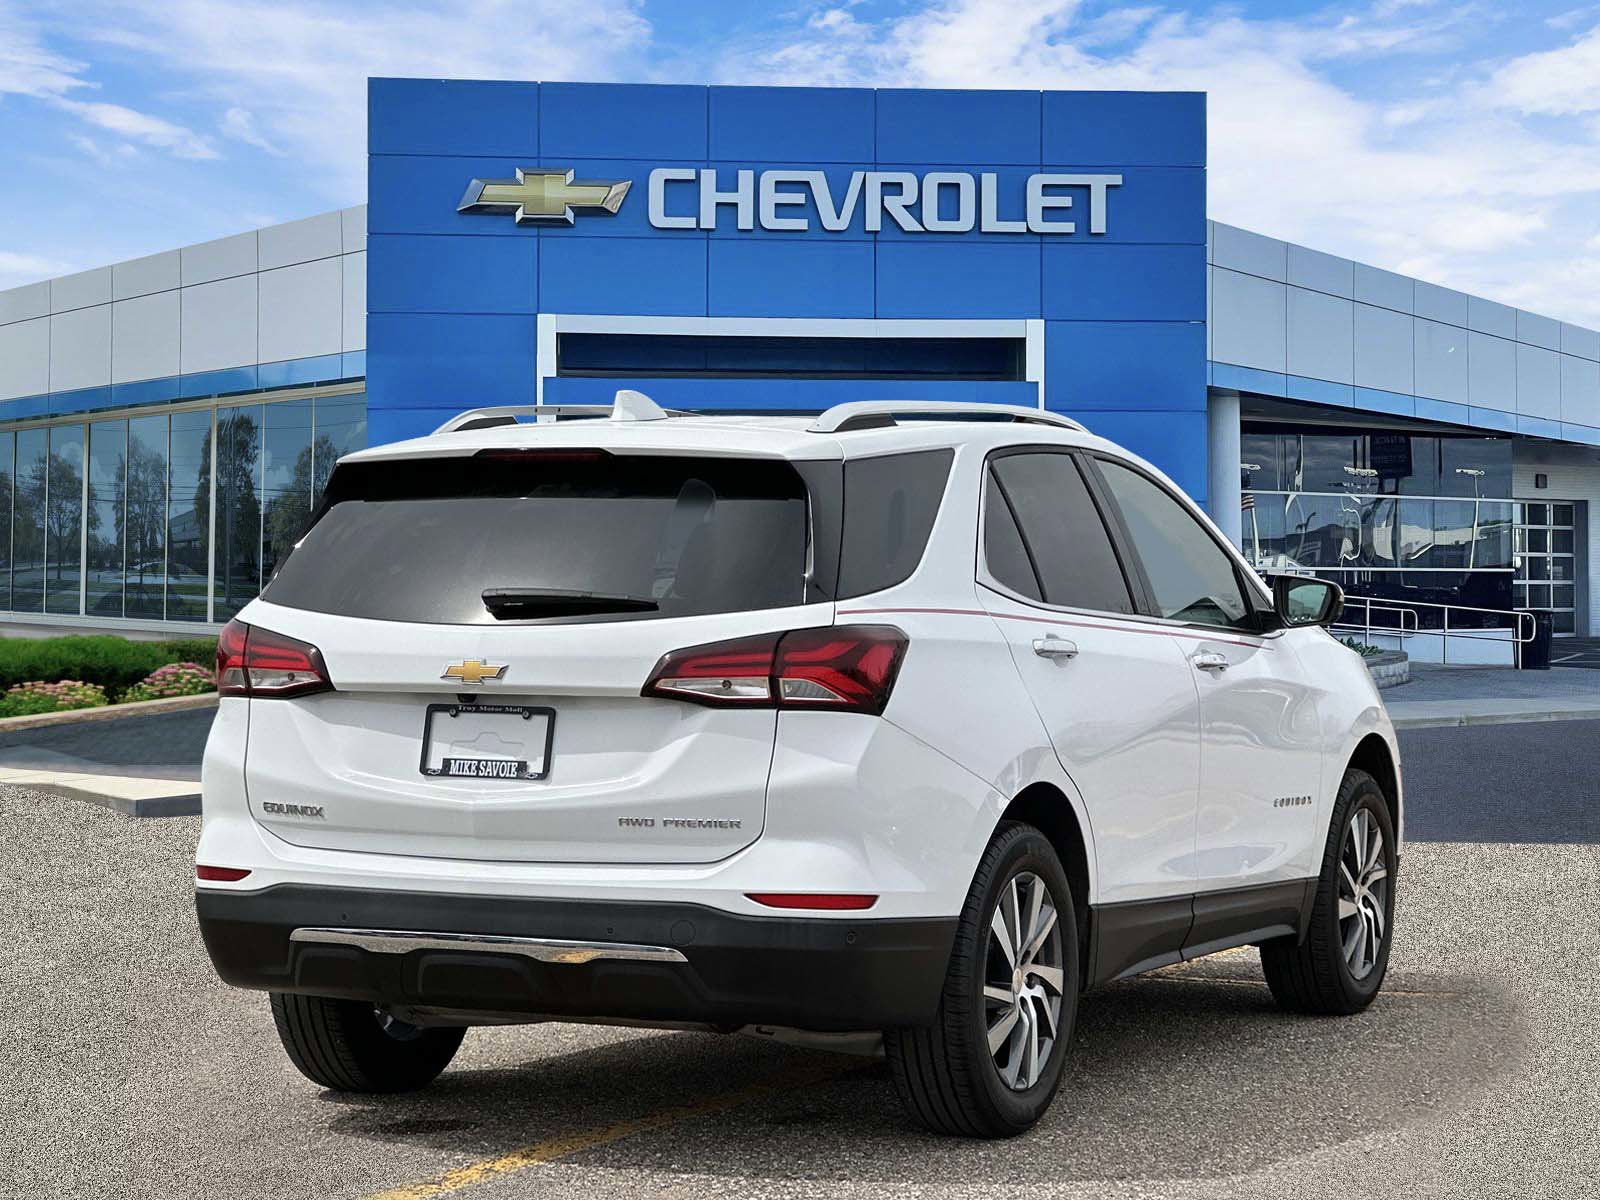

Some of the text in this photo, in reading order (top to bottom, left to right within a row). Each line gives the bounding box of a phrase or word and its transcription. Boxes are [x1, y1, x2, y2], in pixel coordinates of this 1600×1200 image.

[648, 167, 1123, 235] CHEVROLET
[458, 704, 476, 713] Troy
[449, 760, 518, 778] MIKE SAVOIE
[263, 802, 323, 817] EQUINOX
[617, 816, 742, 829] AWD PREMIER
